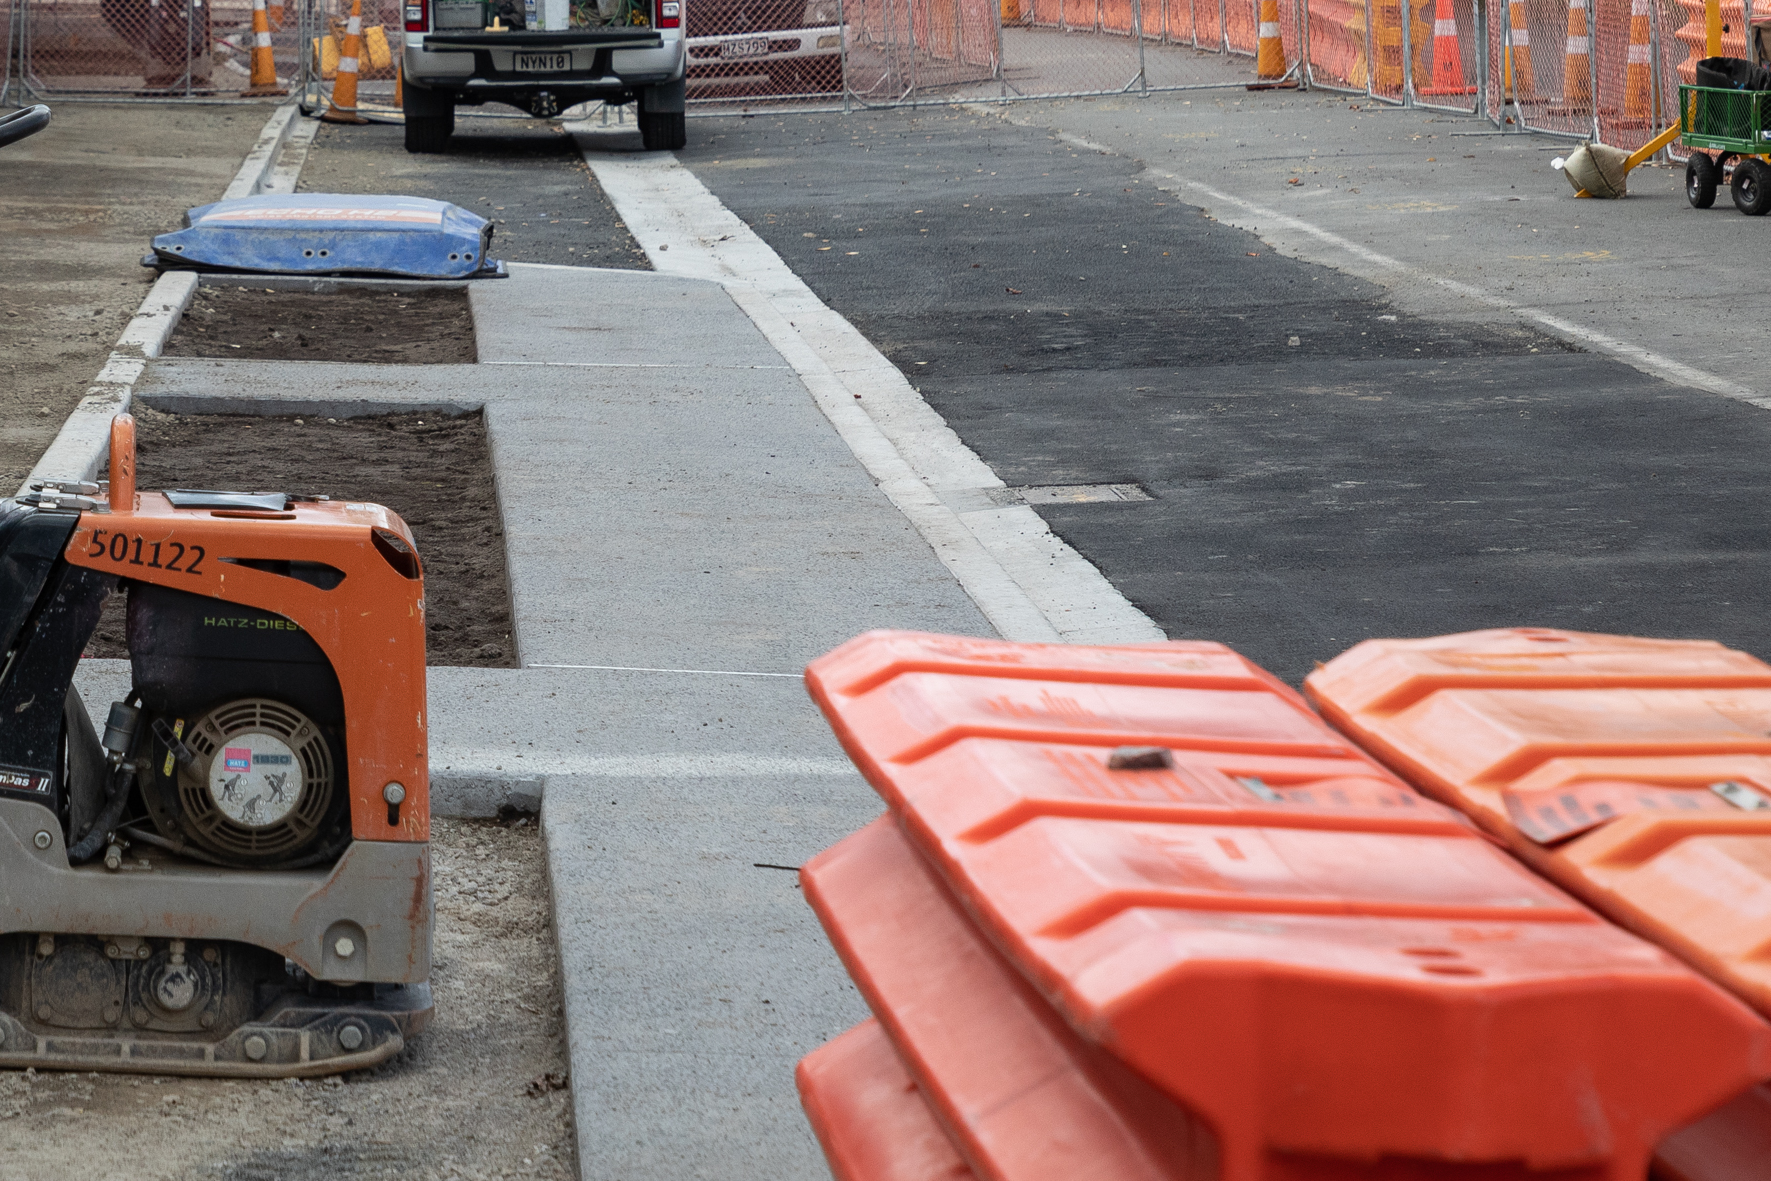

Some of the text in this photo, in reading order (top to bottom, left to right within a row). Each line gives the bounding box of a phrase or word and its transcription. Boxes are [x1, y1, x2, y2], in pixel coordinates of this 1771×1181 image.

[519, 55, 566, 70] NYN10
[87, 529, 206, 575] 501122
[204, 617, 304, 630] HATZ-DIES
